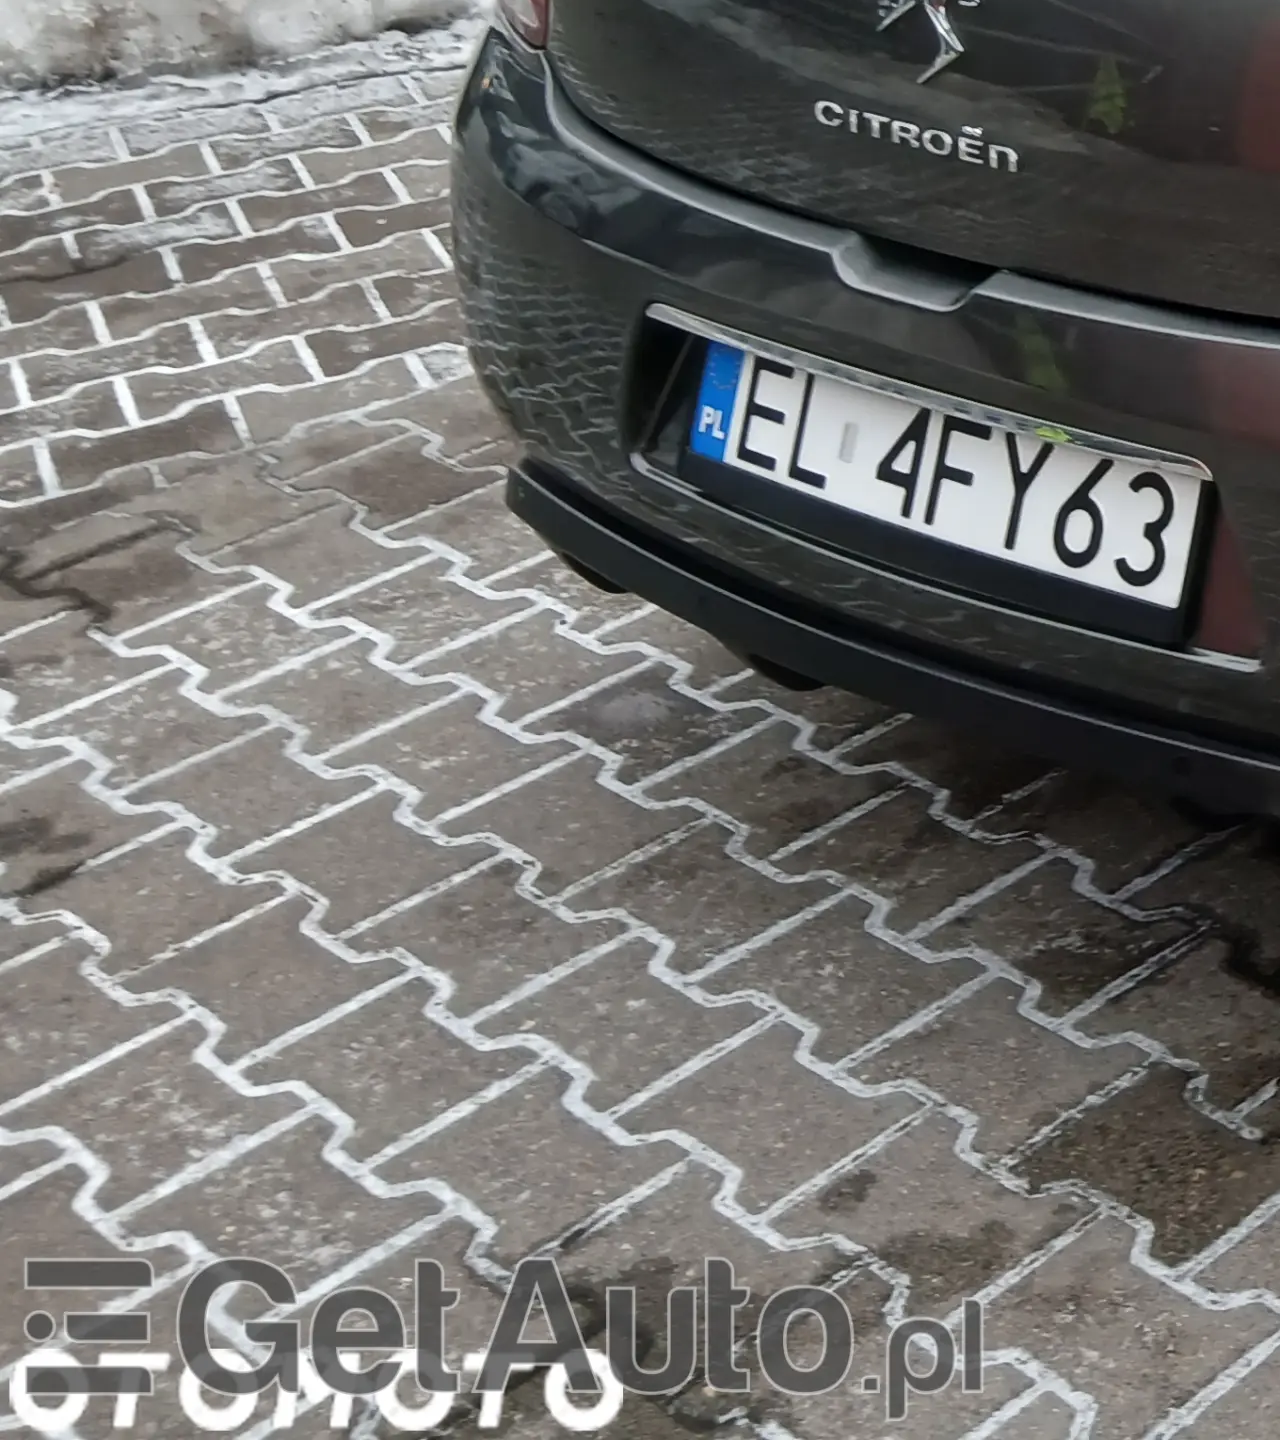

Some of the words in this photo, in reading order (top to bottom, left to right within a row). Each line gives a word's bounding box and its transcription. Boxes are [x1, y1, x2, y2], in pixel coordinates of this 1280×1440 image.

[698, 404, 725, 440] PL
[737, 355, 827, 490] EL
[875, 407, 1175, 587] 4FY63
